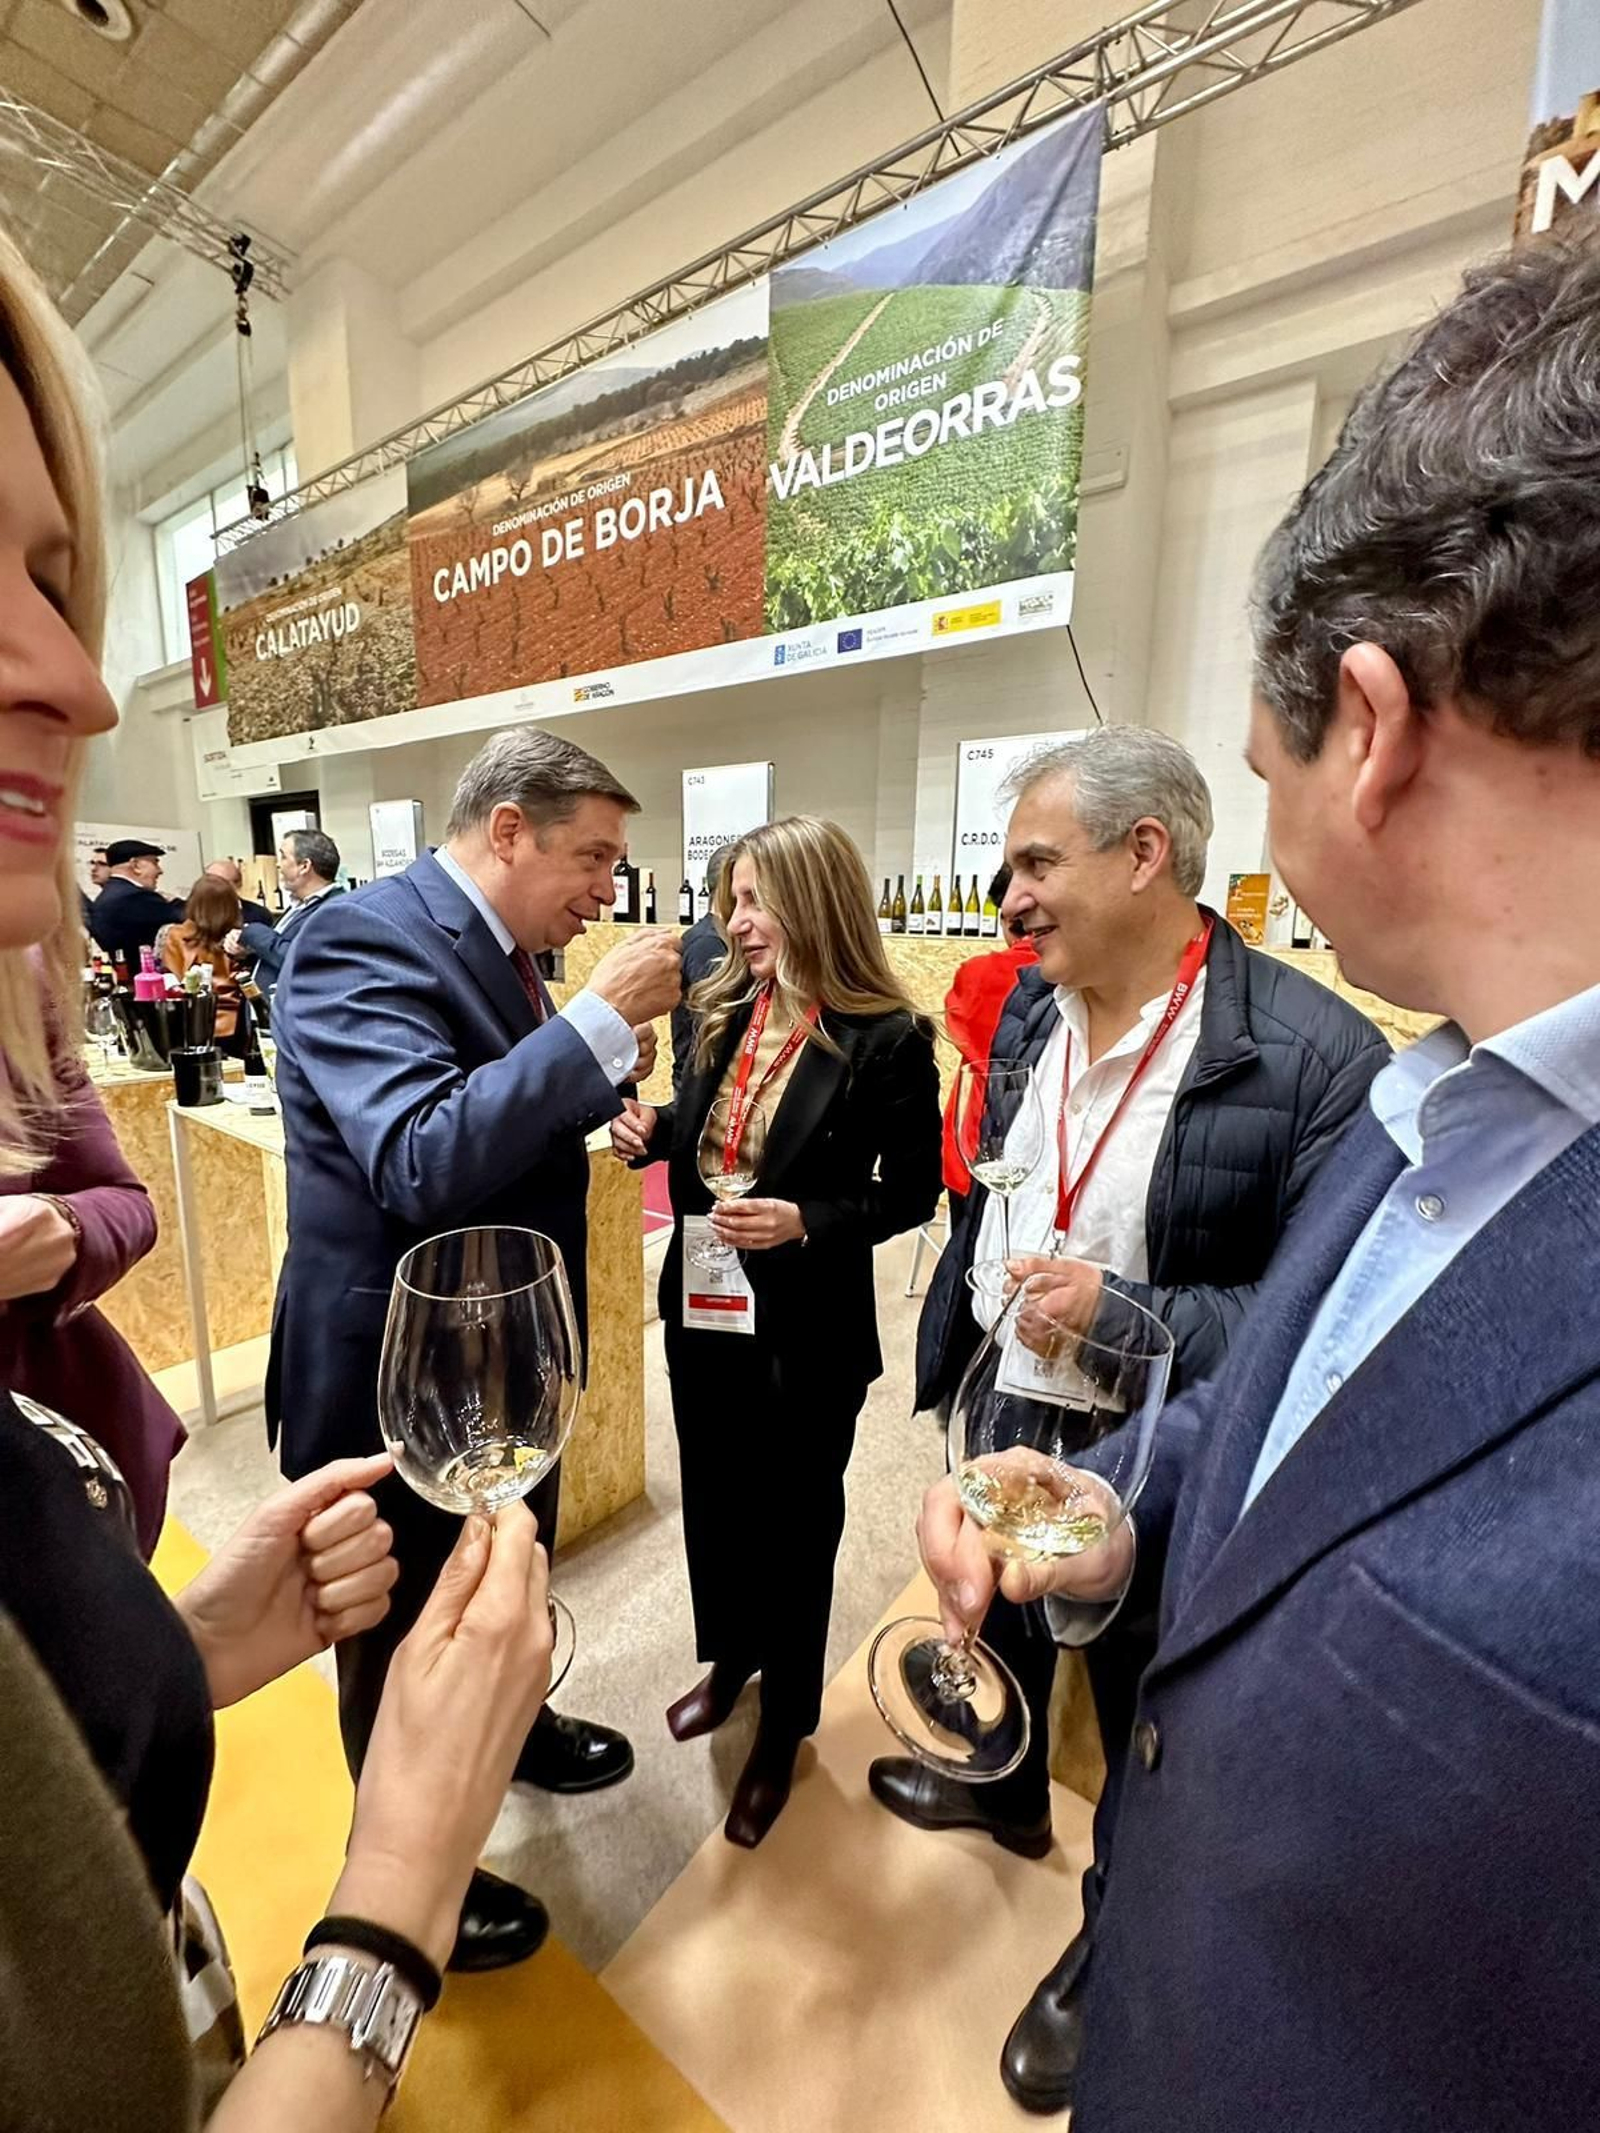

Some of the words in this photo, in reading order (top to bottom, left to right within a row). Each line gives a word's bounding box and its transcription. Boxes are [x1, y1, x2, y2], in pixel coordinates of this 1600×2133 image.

[827, 332, 973, 406] DENOMINACIÓN
[977, 318, 1004, 348] DE
[874, 371, 948, 412] ORIGEN
[768, 354, 1082, 500] VALDEORRAS
[493, 495, 569, 537] DENOMINACIÓN
[570, 489, 586, 506] DE
[587, 472, 632, 501] ORIGEN
[433, 538, 533, 603] CAMPO
[541, 517, 586, 568] DE
[595, 468, 726, 551] BORJA
[255, 601, 361, 661] CALATAYUD
[967, 748, 995, 761] C745
[687, 775, 706, 785] C743
[960, 832, 1002, 846] C.R.D.O.
[1167, 982, 1189, 1020] BWW
